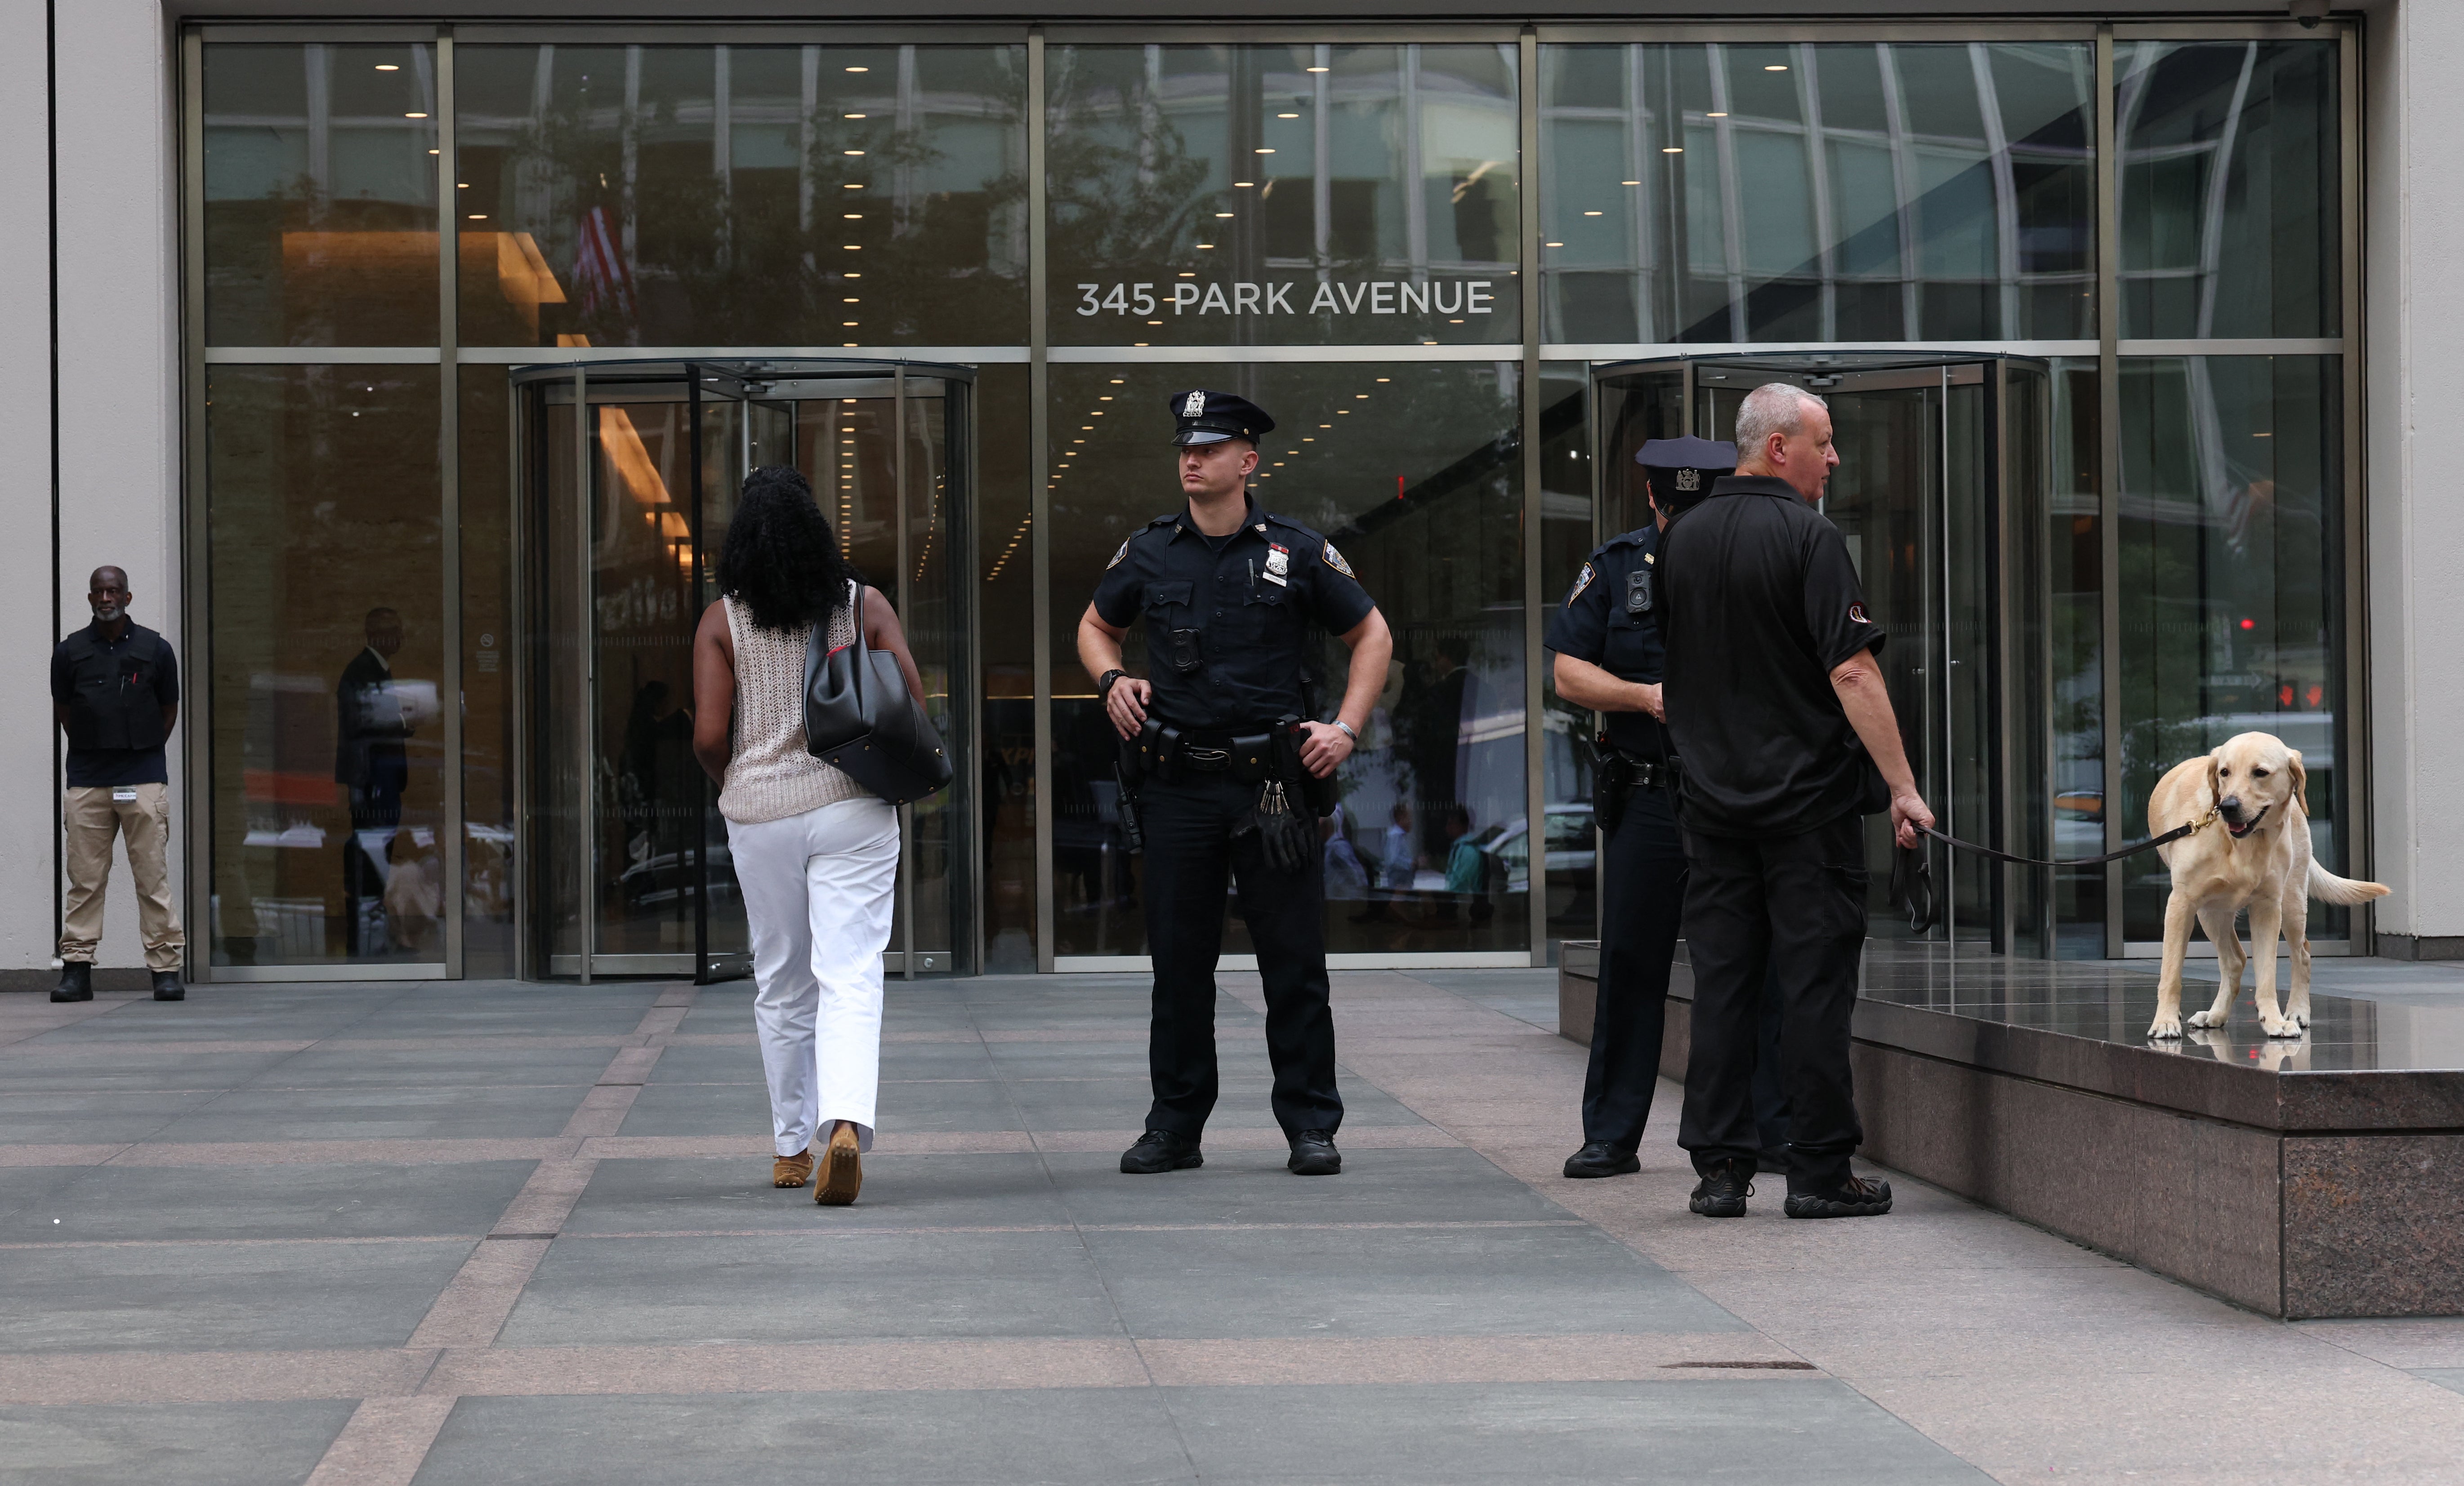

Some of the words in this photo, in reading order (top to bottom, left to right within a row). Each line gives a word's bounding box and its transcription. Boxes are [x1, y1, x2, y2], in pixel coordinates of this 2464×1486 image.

[1076, 283, 1155, 316] 345
[1174, 282, 1295, 315] PARK
[1308, 281, 1492, 314] AVENUE
[1270, 562, 1286, 573] 14263
